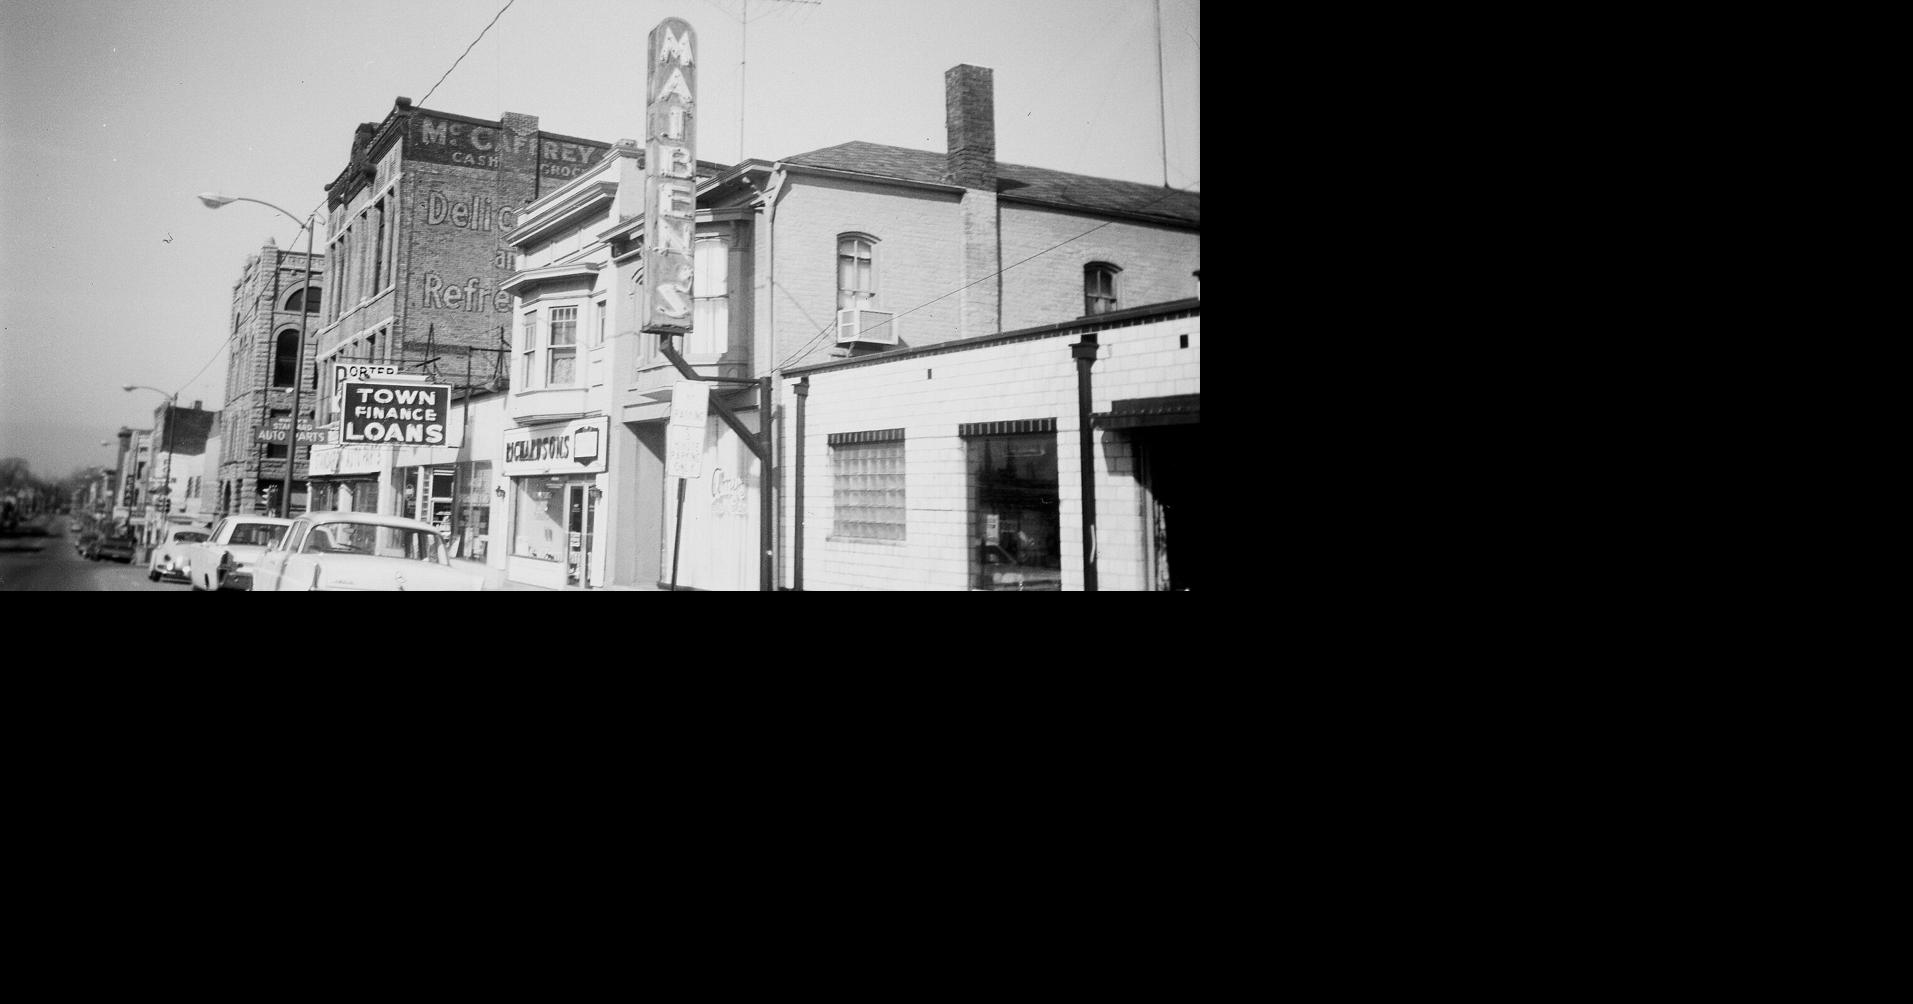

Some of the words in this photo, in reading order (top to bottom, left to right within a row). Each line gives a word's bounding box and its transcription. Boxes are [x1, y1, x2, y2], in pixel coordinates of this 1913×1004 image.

[451, 151, 500, 167] CASH
[539, 163, 588, 178] GROC
[427, 190, 518, 232] Delic
[494, 248, 517, 270] an
[422, 271, 514, 314] Refre
[356, 388, 436, 406] TOWN
[354, 406, 437, 421] FINANCE
[258, 430, 286, 441] AUTO
[345, 421, 444, 443] LOANS
